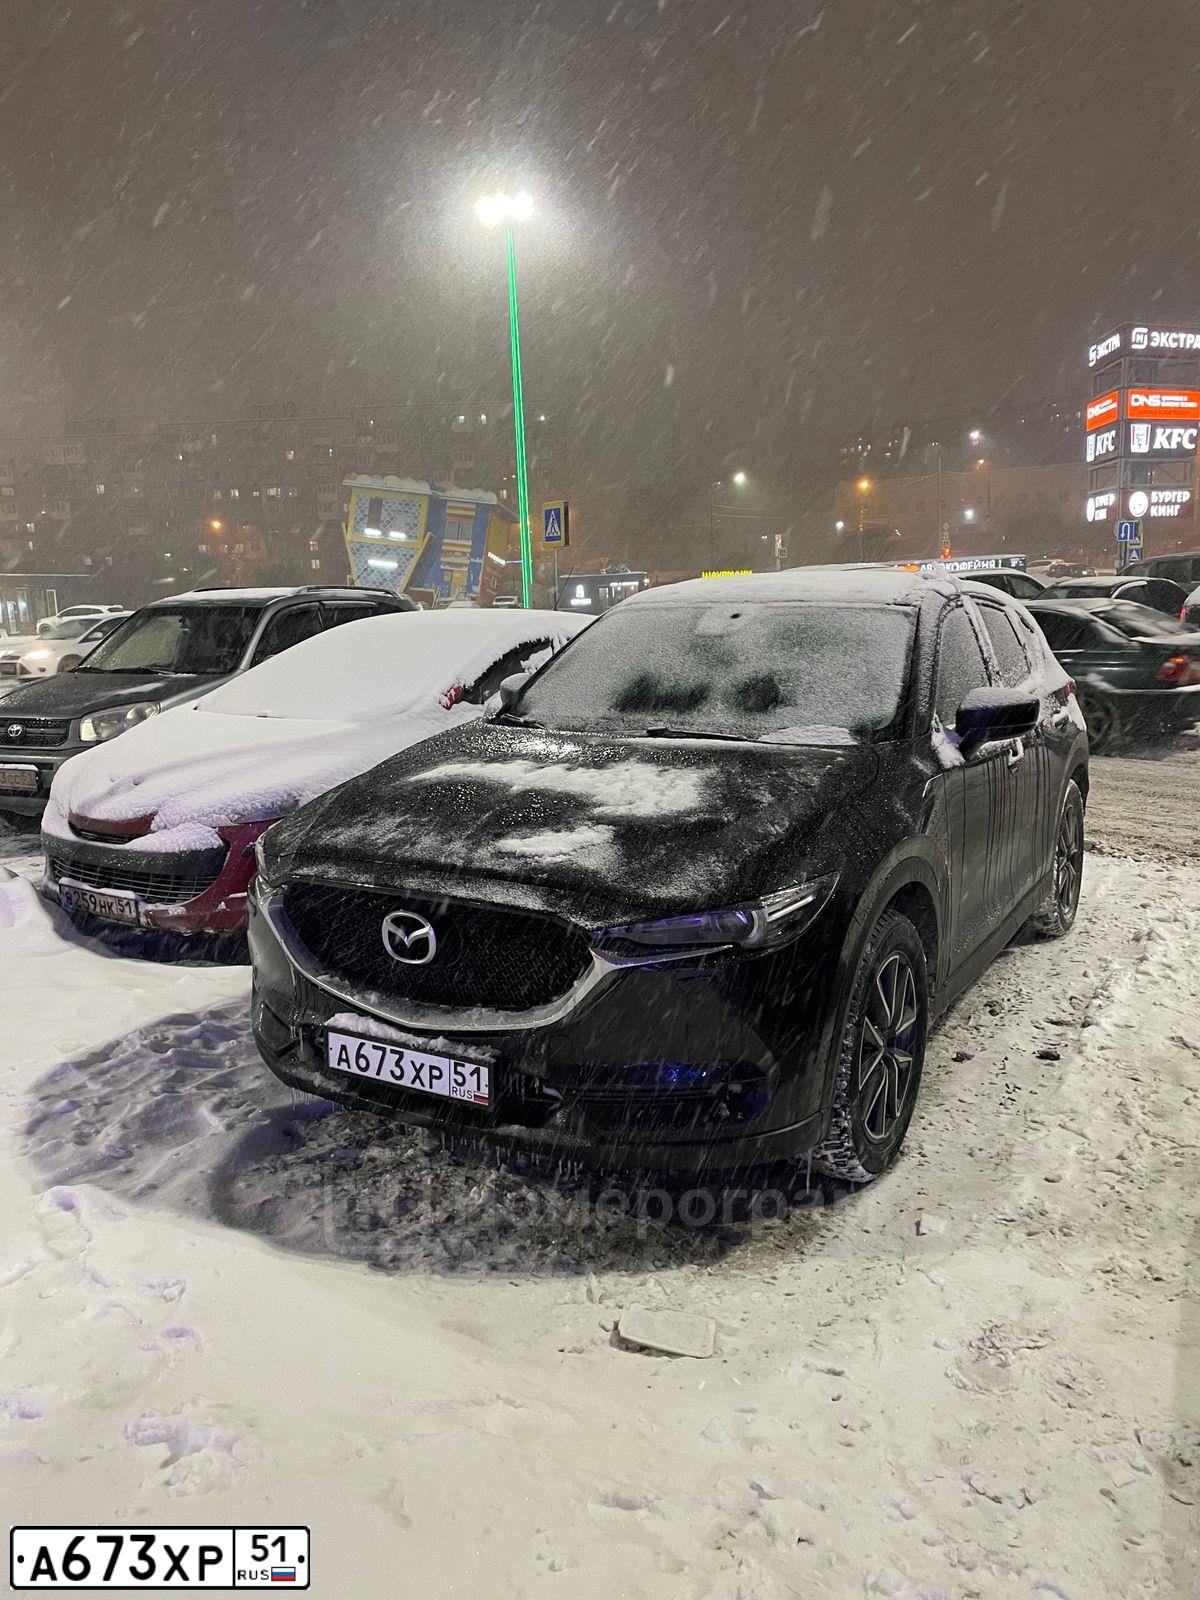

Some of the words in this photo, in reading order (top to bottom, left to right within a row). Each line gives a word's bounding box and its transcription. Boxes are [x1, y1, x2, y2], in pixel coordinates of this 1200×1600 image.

[1150, 331, 1200, 349] ЭКСТРА
[1131, 394, 1161, 407] DNS
[1153, 428, 1197, 449] KFC
[1151, 491, 1190, 503] БУРГЕР
[1151, 505, 1180, 517] КИНГ
[65, 890, 115, 916] В259НК
[117, 899, 132, 914] 51
[337, 1042, 443, 1089] А673ХР
[453, 1062, 481, 1091] 51
[452, 1087, 473, 1100] RUS
